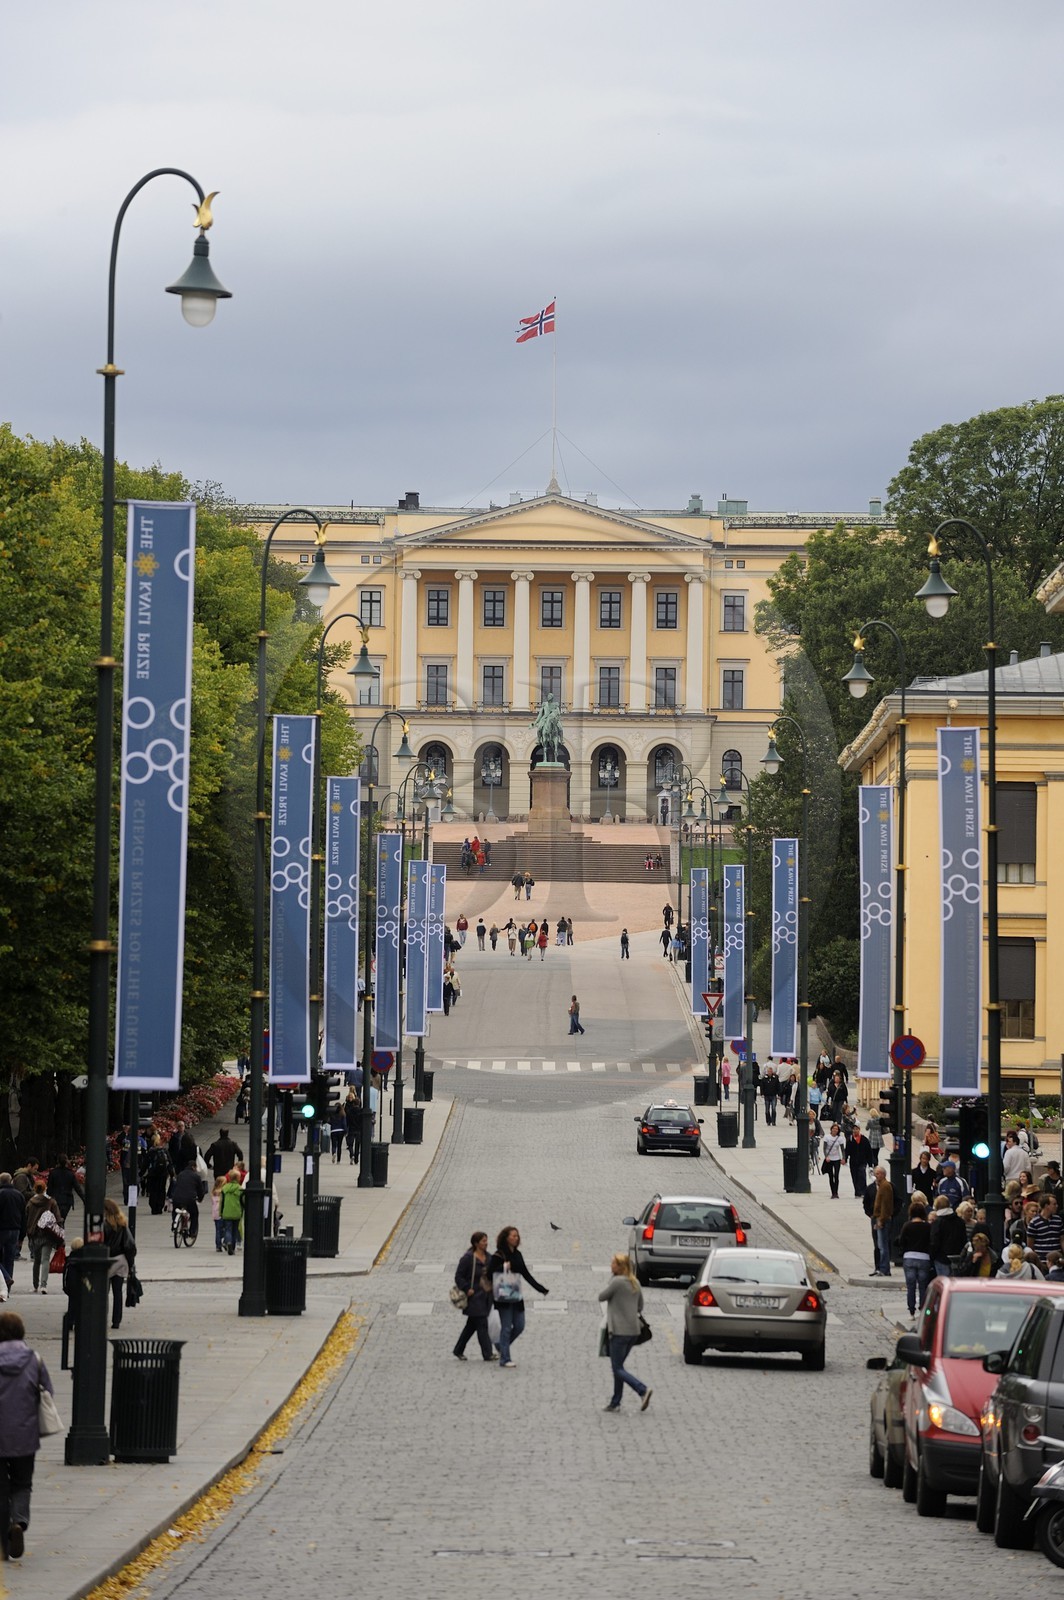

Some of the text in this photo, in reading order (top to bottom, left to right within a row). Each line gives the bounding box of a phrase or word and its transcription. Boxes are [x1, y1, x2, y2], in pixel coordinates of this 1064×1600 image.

[963, 736, 975, 838] THE KAVLI PRIZE
[880, 823, 888, 846] KAVLI
[880, 849, 888, 874] PRIZE
